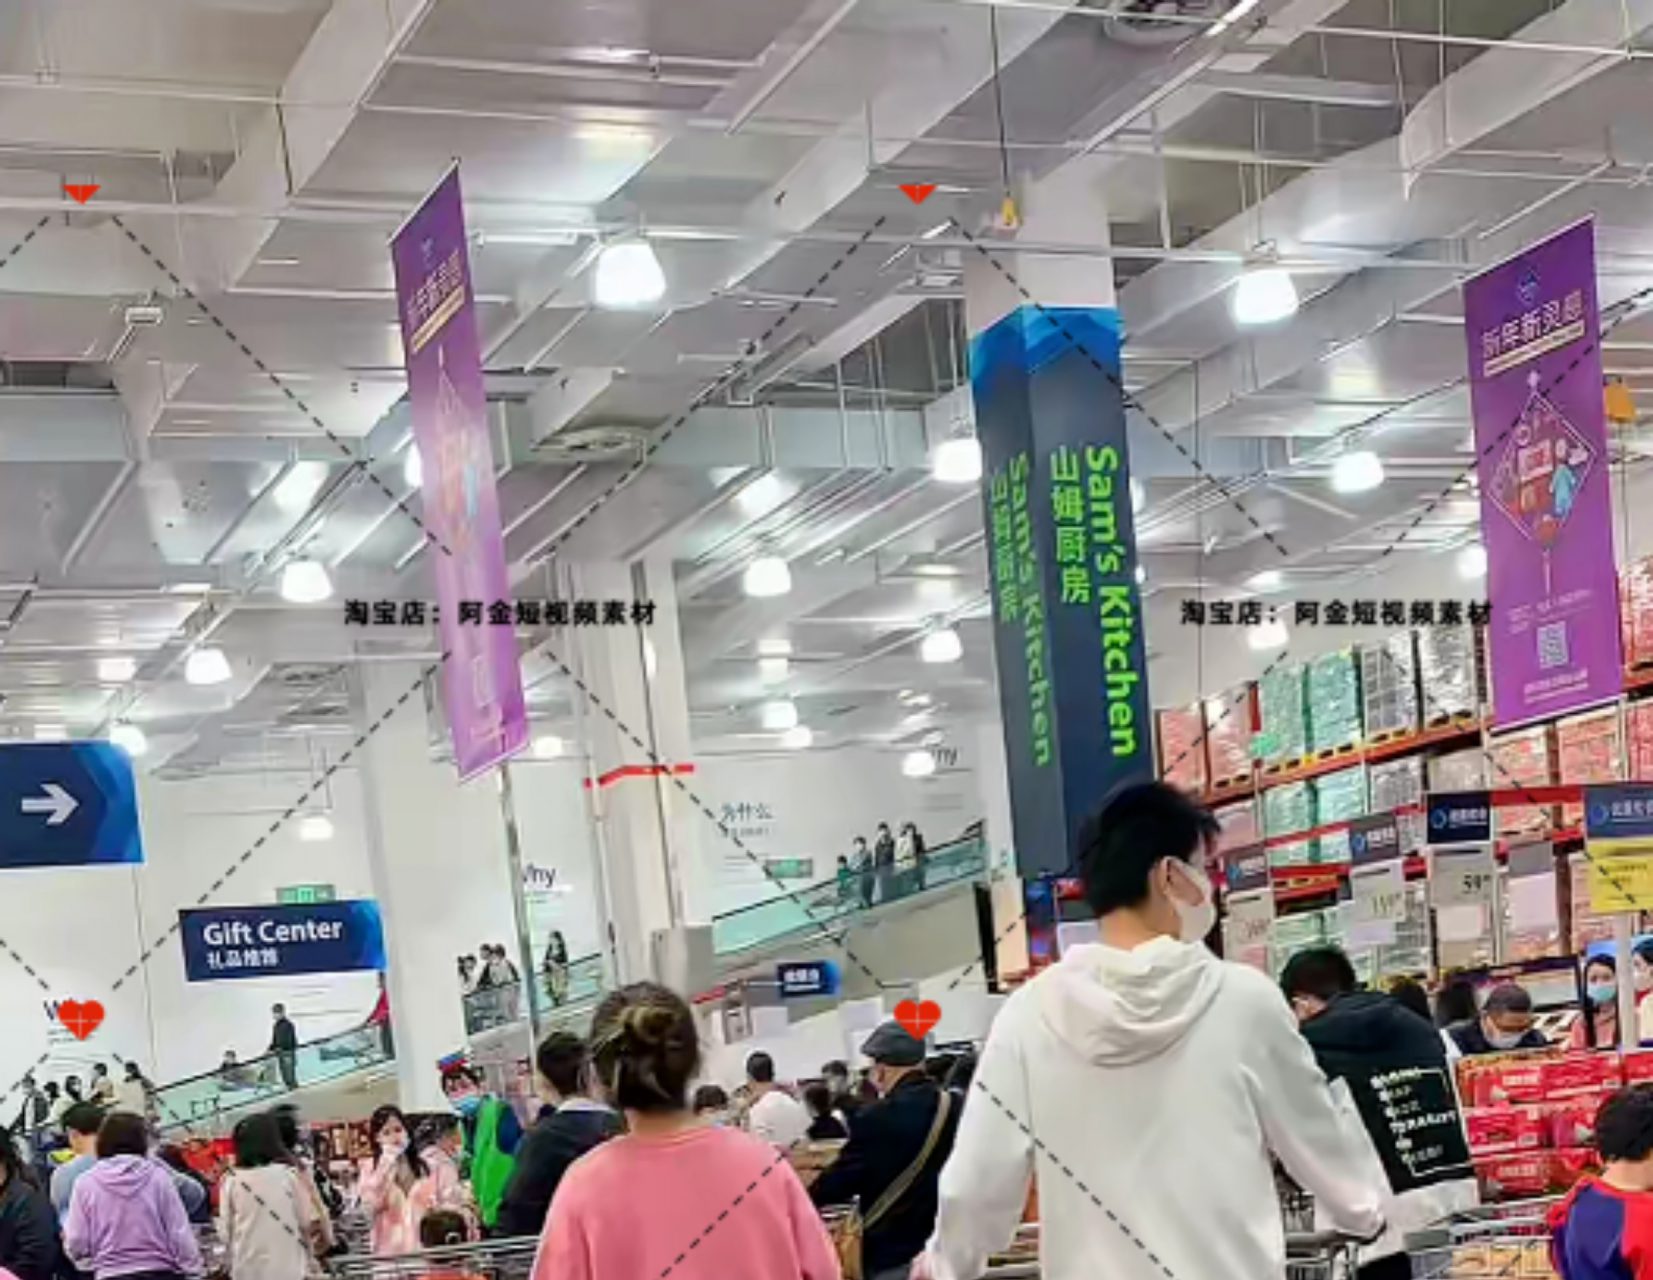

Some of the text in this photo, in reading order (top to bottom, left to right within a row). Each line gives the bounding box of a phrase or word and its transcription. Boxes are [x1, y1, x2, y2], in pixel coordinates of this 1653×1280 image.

[1050, 446, 1091, 604] 山姆厨房
[1021, 591, 1051, 767] Kitchen
[1099, 585, 1140, 756] Kitchen
[203, 920, 343, 945] Gift Center
